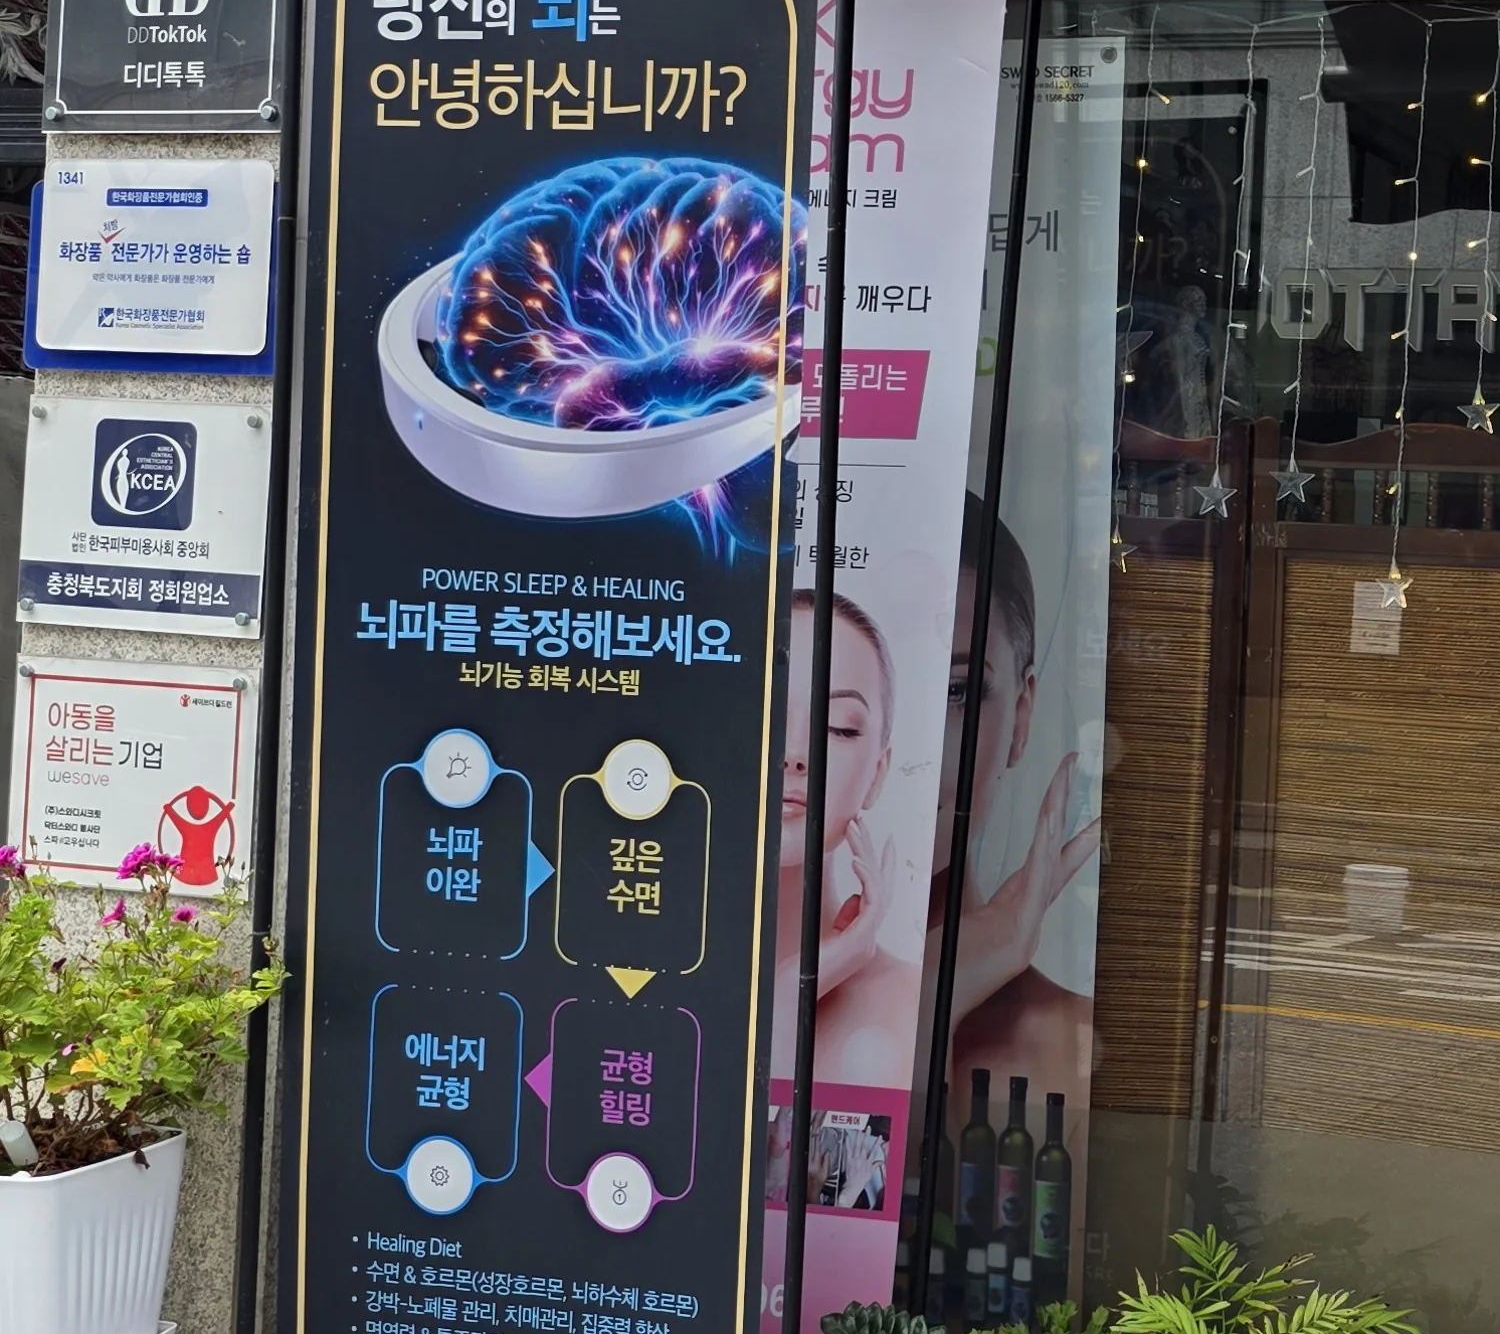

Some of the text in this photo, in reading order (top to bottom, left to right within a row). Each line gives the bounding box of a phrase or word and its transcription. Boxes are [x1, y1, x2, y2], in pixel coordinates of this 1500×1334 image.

[127, 24, 207, 44] DDTokTok
[123, 61, 207, 88] 디디톡톡
[369, 58, 748, 133] 안녕하십니까?
[58, 172, 84, 185] 1341
[863, 189, 897, 208] 크림
[59, 241, 252, 265] 화장품 전문가가 운영하는 숍
[116, 307, 205, 324] 한국화장품전문가협회
[856, 285, 931, 313] 깨우다
[130, 473, 176, 491] KCEA
[89, 534, 210, 560] 한국피부미용사회 중앙회
[47, 571, 230, 607] 충청북도지회 정회원업소
[422, 568, 685, 602] POWER SLEEP & HEALING
[356, 599, 742, 665] 뇌파를 측정해보세요.
[459, 661, 640, 696] 뇌기능 회복 시스템
[48, 702, 116, 732] 아동을
[46, 735, 163, 770] 살리는 기업
[47, 770, 110, 787] wesave
[426, 826, 483, 862] 뇌파
[609, 838, 664, 874] 깊은
[426, 867, 481, 902] 이완
[606, 881, 661, 915] 수면
[404, 1033, 486, 1072] 에너지
[600, 1048, 653, 1087] 균형
[416, 1074, 470, 1111] 균형
[600, 1089, 652, 1127] 힐링
[366, 1231, 462, 1259] Healing Diet
[365, 1260, 400, 1285] 수면
[403, 1266, 417, 1285] &
[571, 1281, 639, 1312] 뇌하수체
[642, 1290, 700, 1319] 호르몬)
[461, 1300, 500, 1326] 관리,
[504, 1304, 577, 1334] 치매관리,
